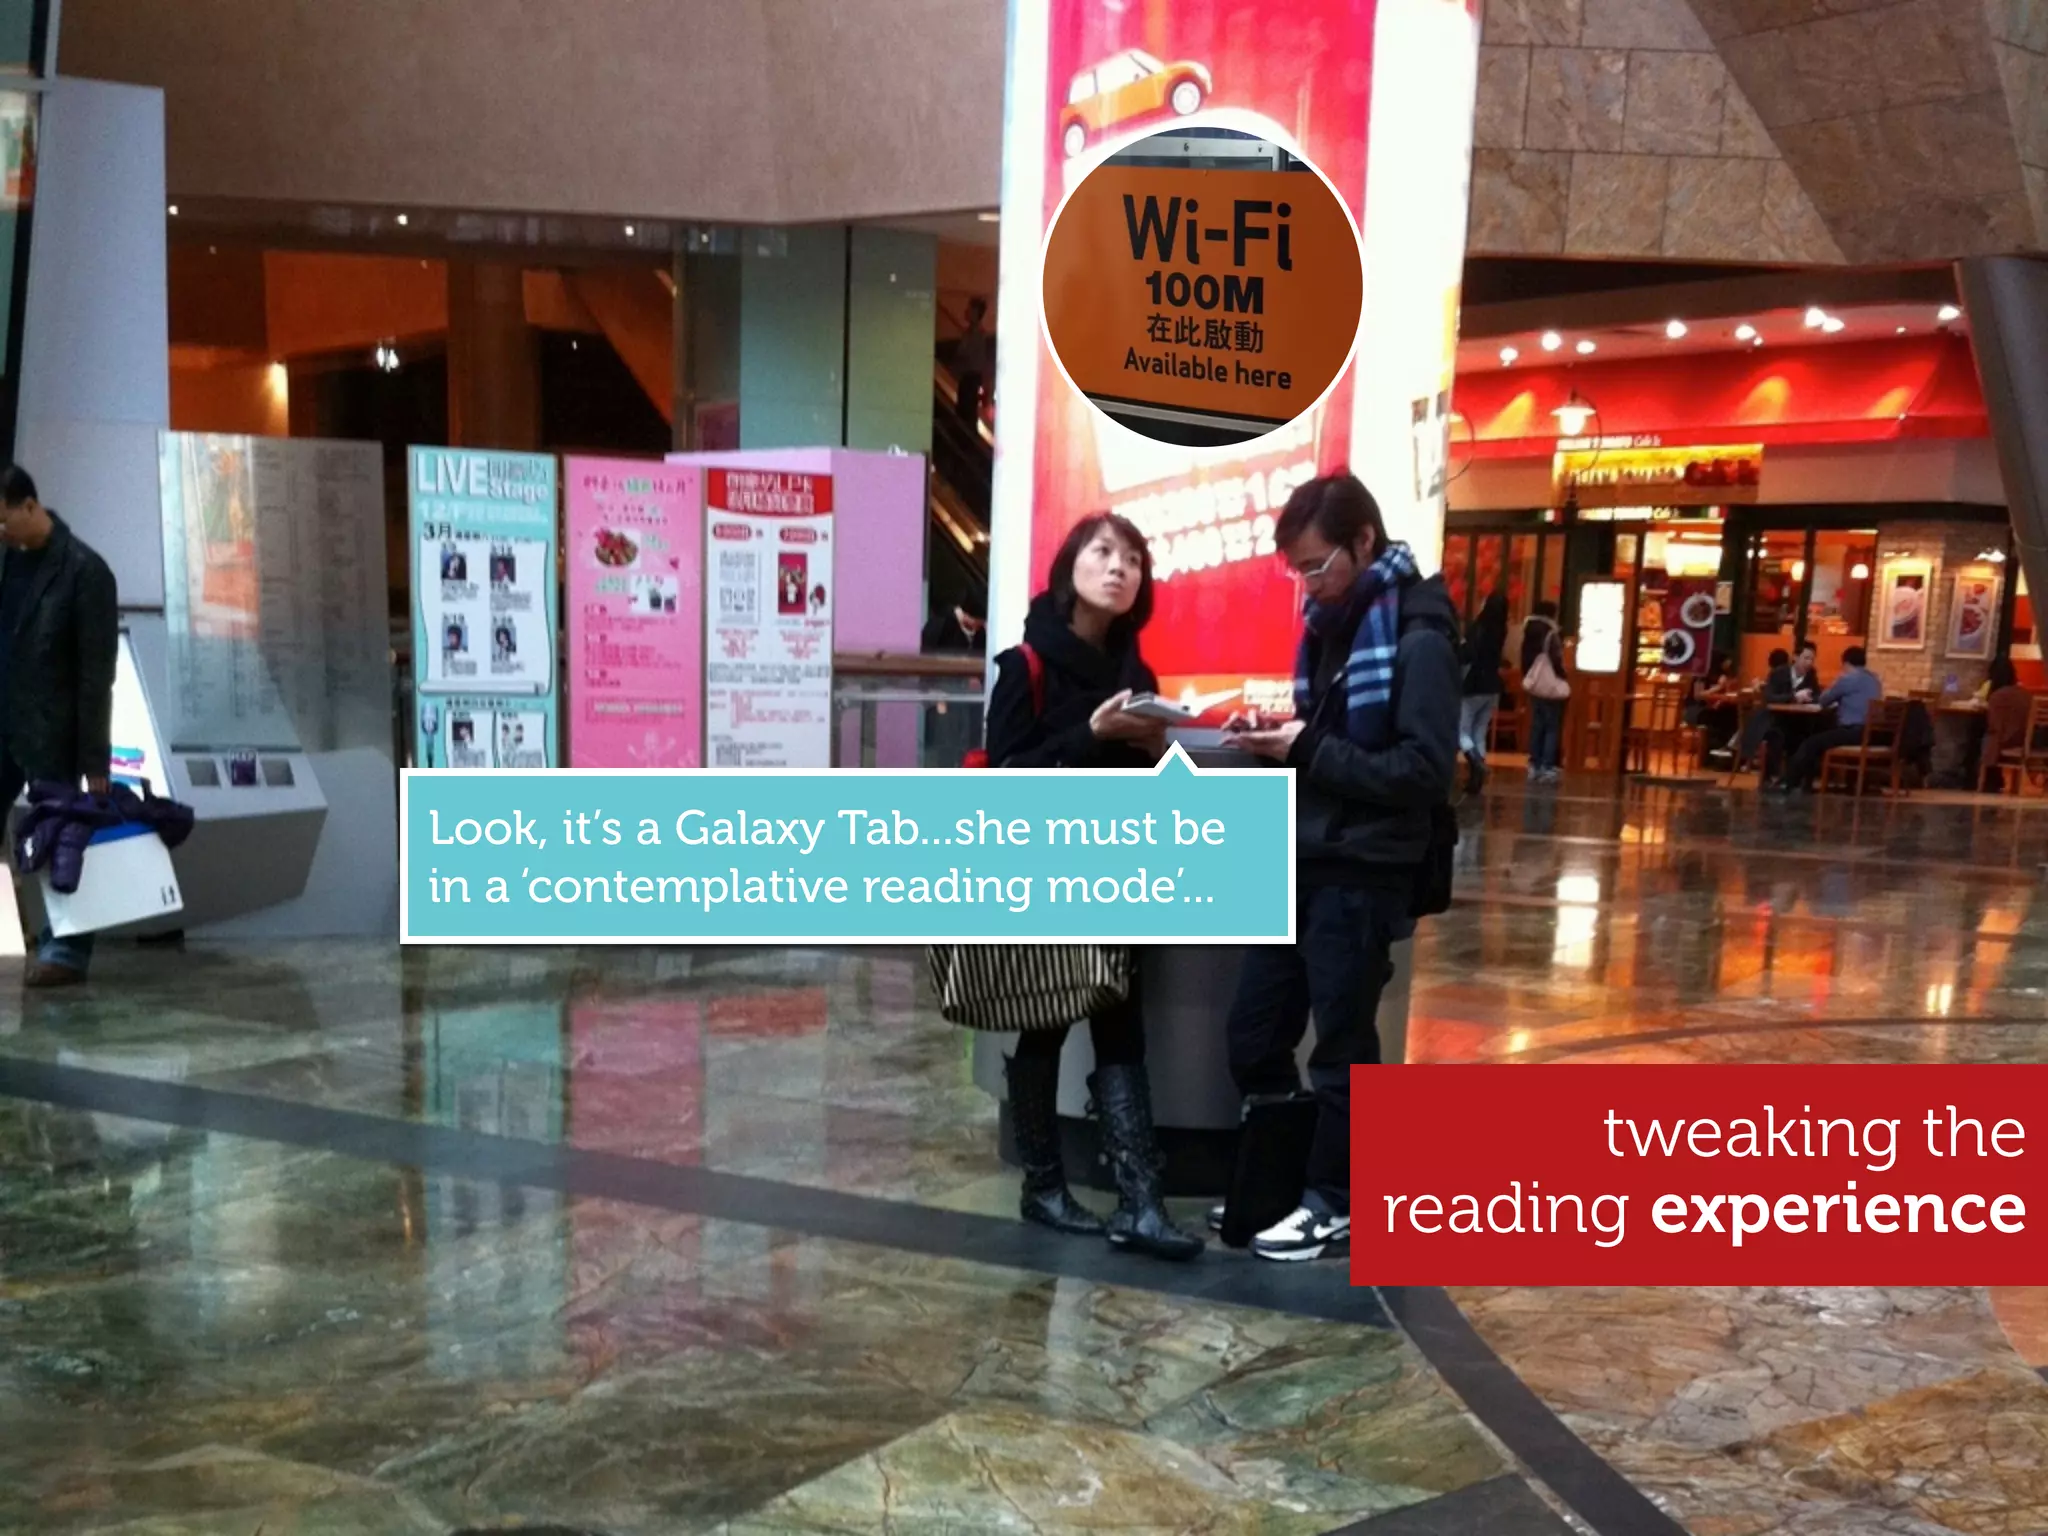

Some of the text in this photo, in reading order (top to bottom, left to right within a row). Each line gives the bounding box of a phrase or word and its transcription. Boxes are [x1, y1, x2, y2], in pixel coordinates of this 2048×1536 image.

[1123, 194, 1293, 272] Wi-Fi
[1145, 270, 1264, 315] 100M
[1123, 346, 1292, 390] Available here
[416, 453, 488, 496] LIVE
[488, 479, 549, 506] Stage
